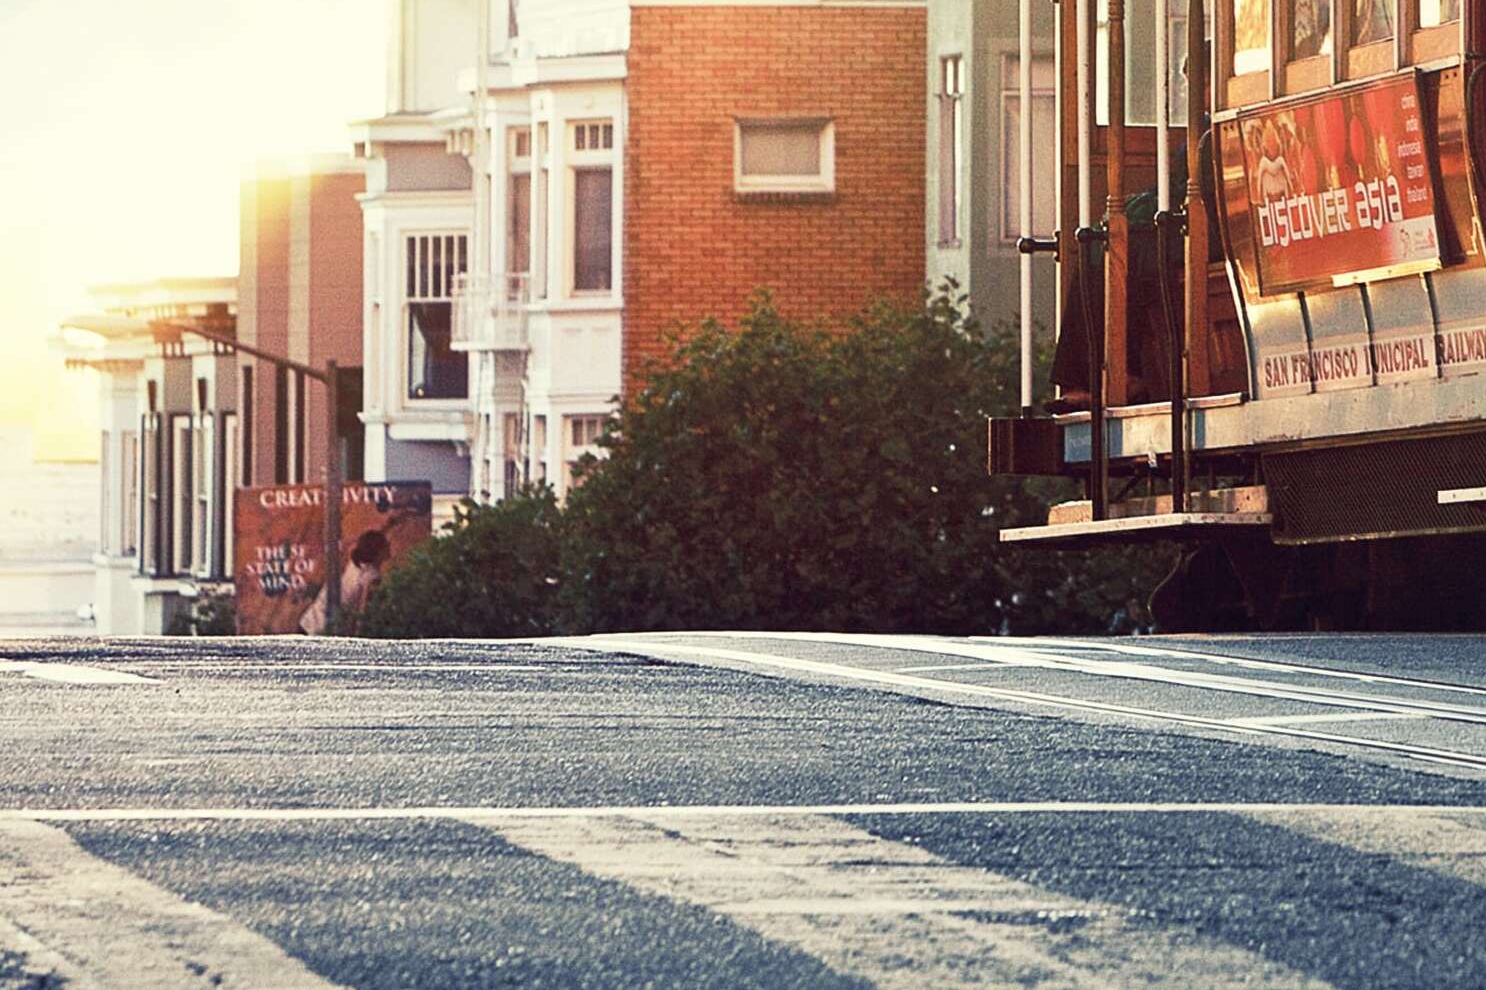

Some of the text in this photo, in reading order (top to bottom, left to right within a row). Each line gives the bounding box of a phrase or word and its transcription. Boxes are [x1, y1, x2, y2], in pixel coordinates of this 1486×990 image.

[1264, 355, 1290, 389] SAN
[245, 558, 316, 576] STATE OF
